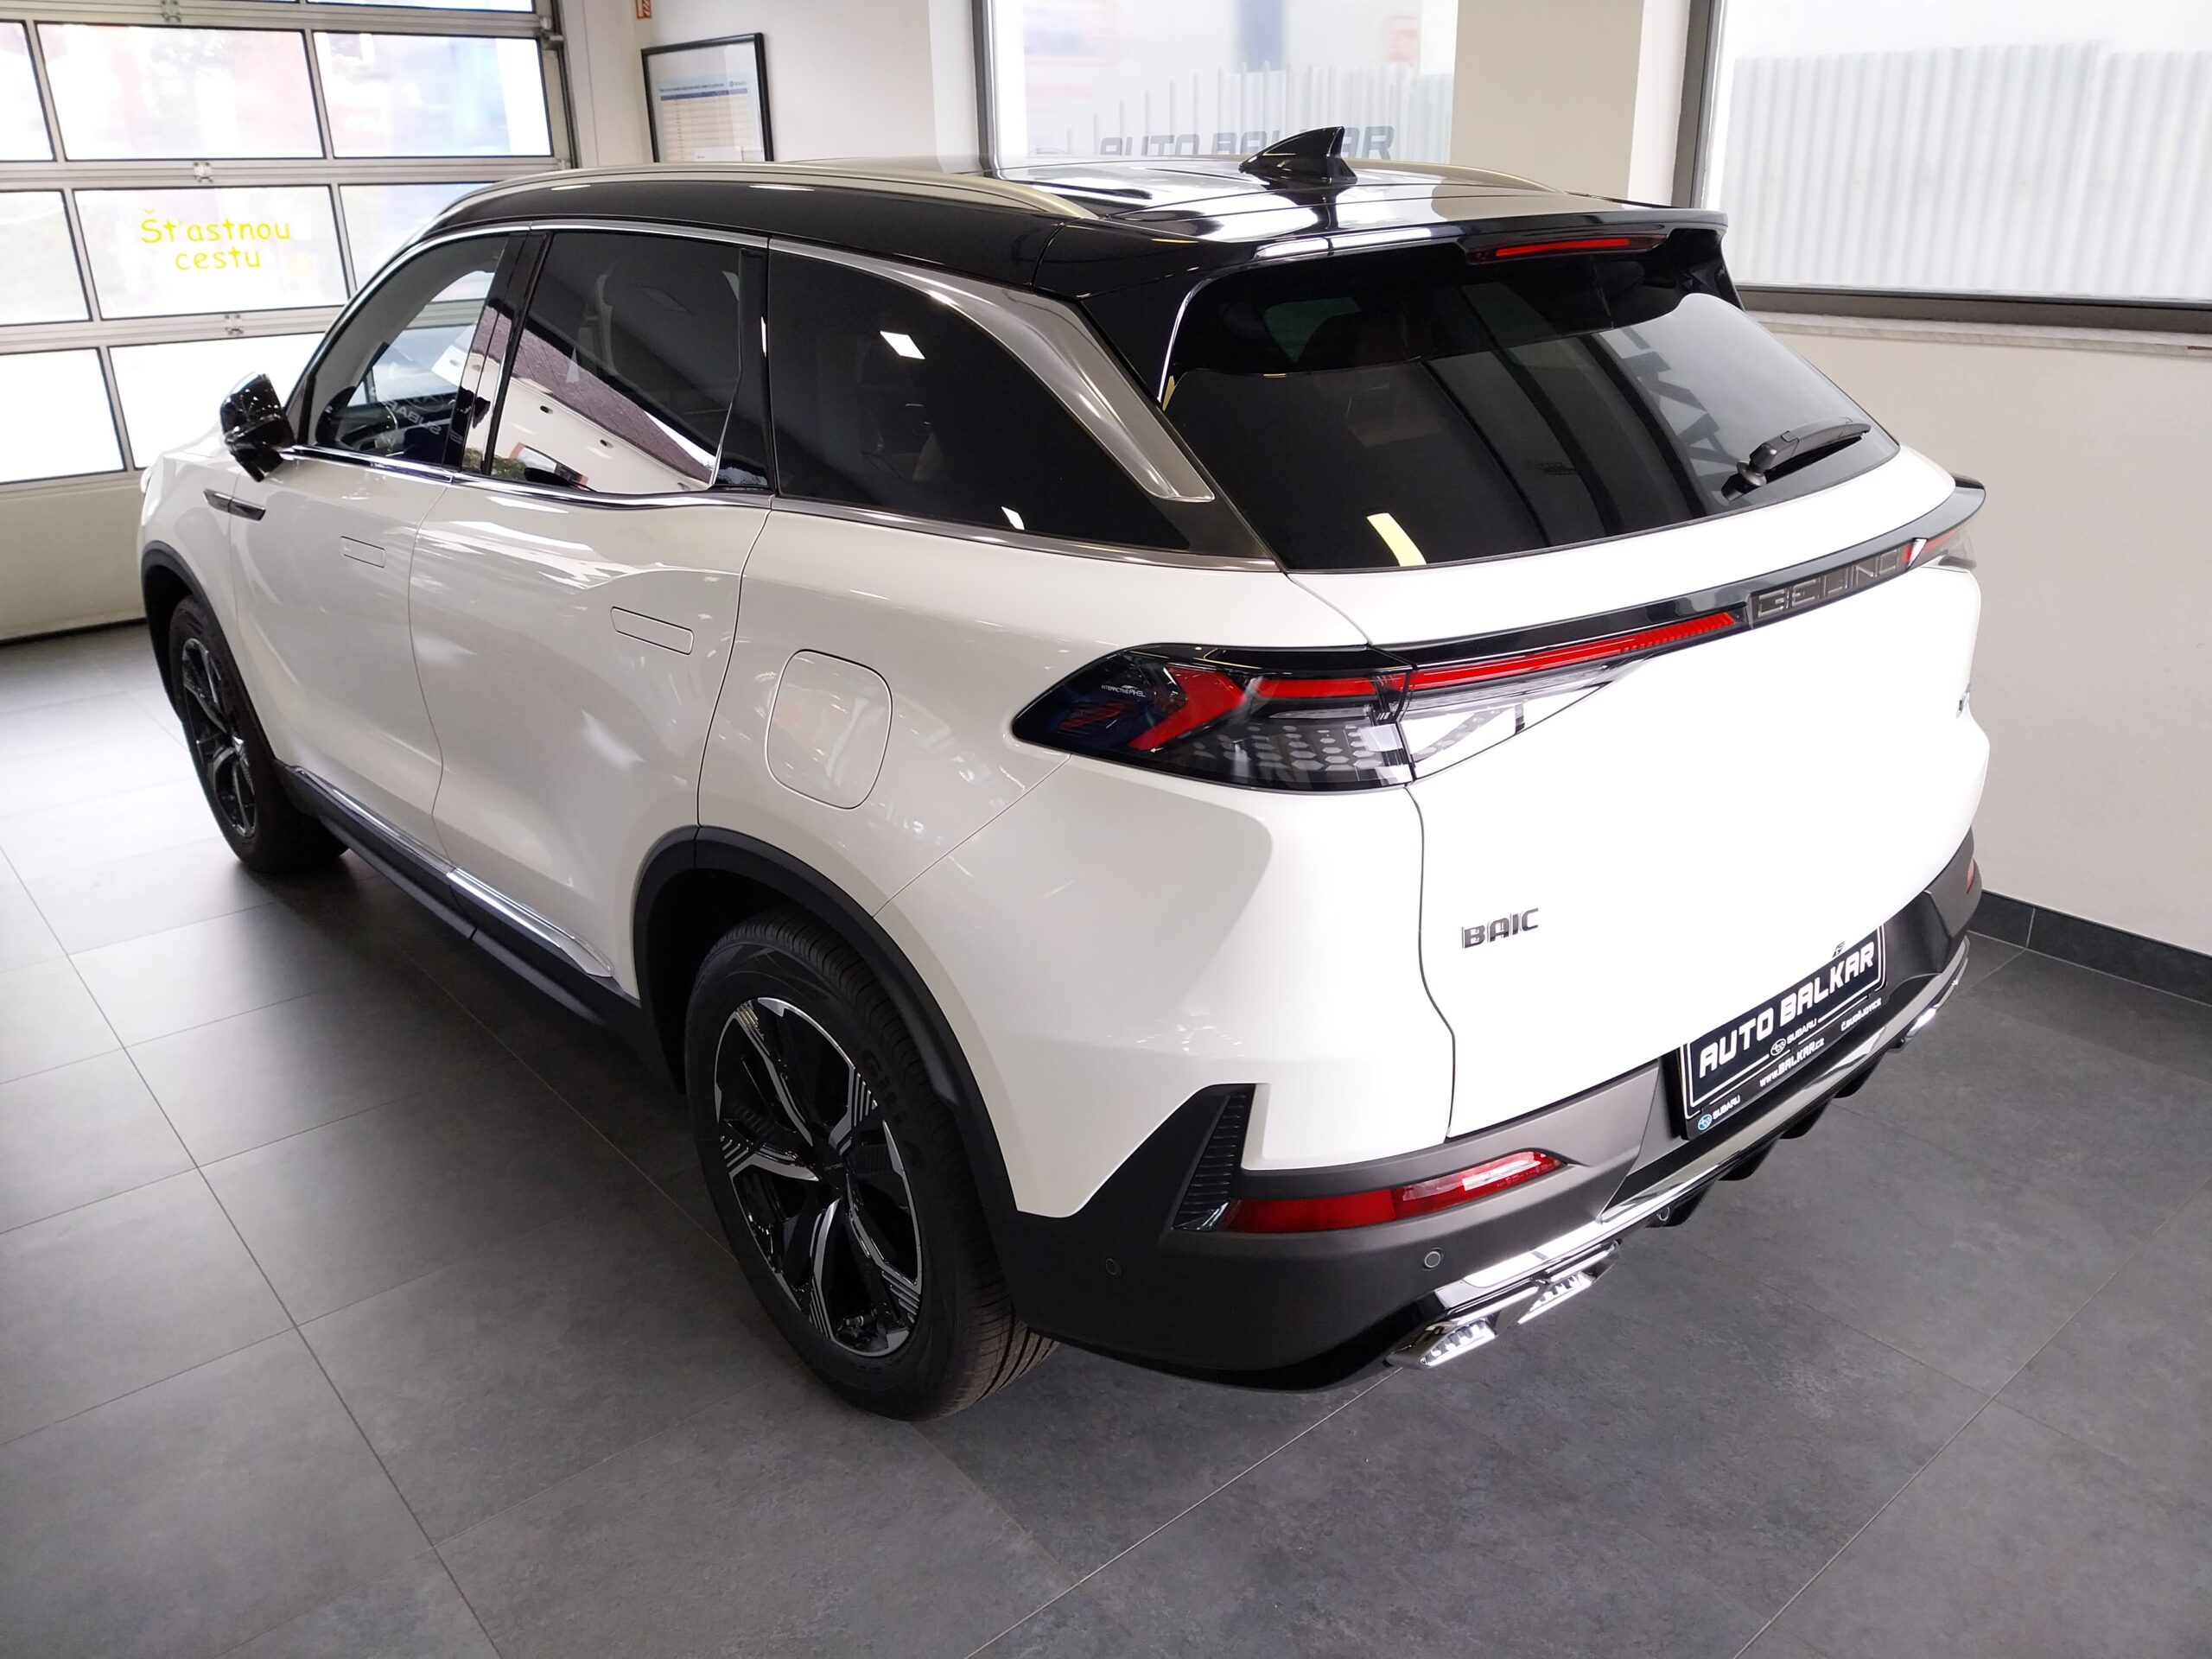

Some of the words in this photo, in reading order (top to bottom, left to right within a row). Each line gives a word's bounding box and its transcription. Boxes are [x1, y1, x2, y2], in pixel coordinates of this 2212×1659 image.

[175, 246, 262, 270] cestu
[1461, 907, 1539, 950] BAIC
[1699, 1007, 1774, 1078] AUTO
[1780, 941, 1875, 1027] BALKAR
[1786, 1018, 1818, 1045] SUBARU
[1712, 1095, 1741, 1120] SUBARU
